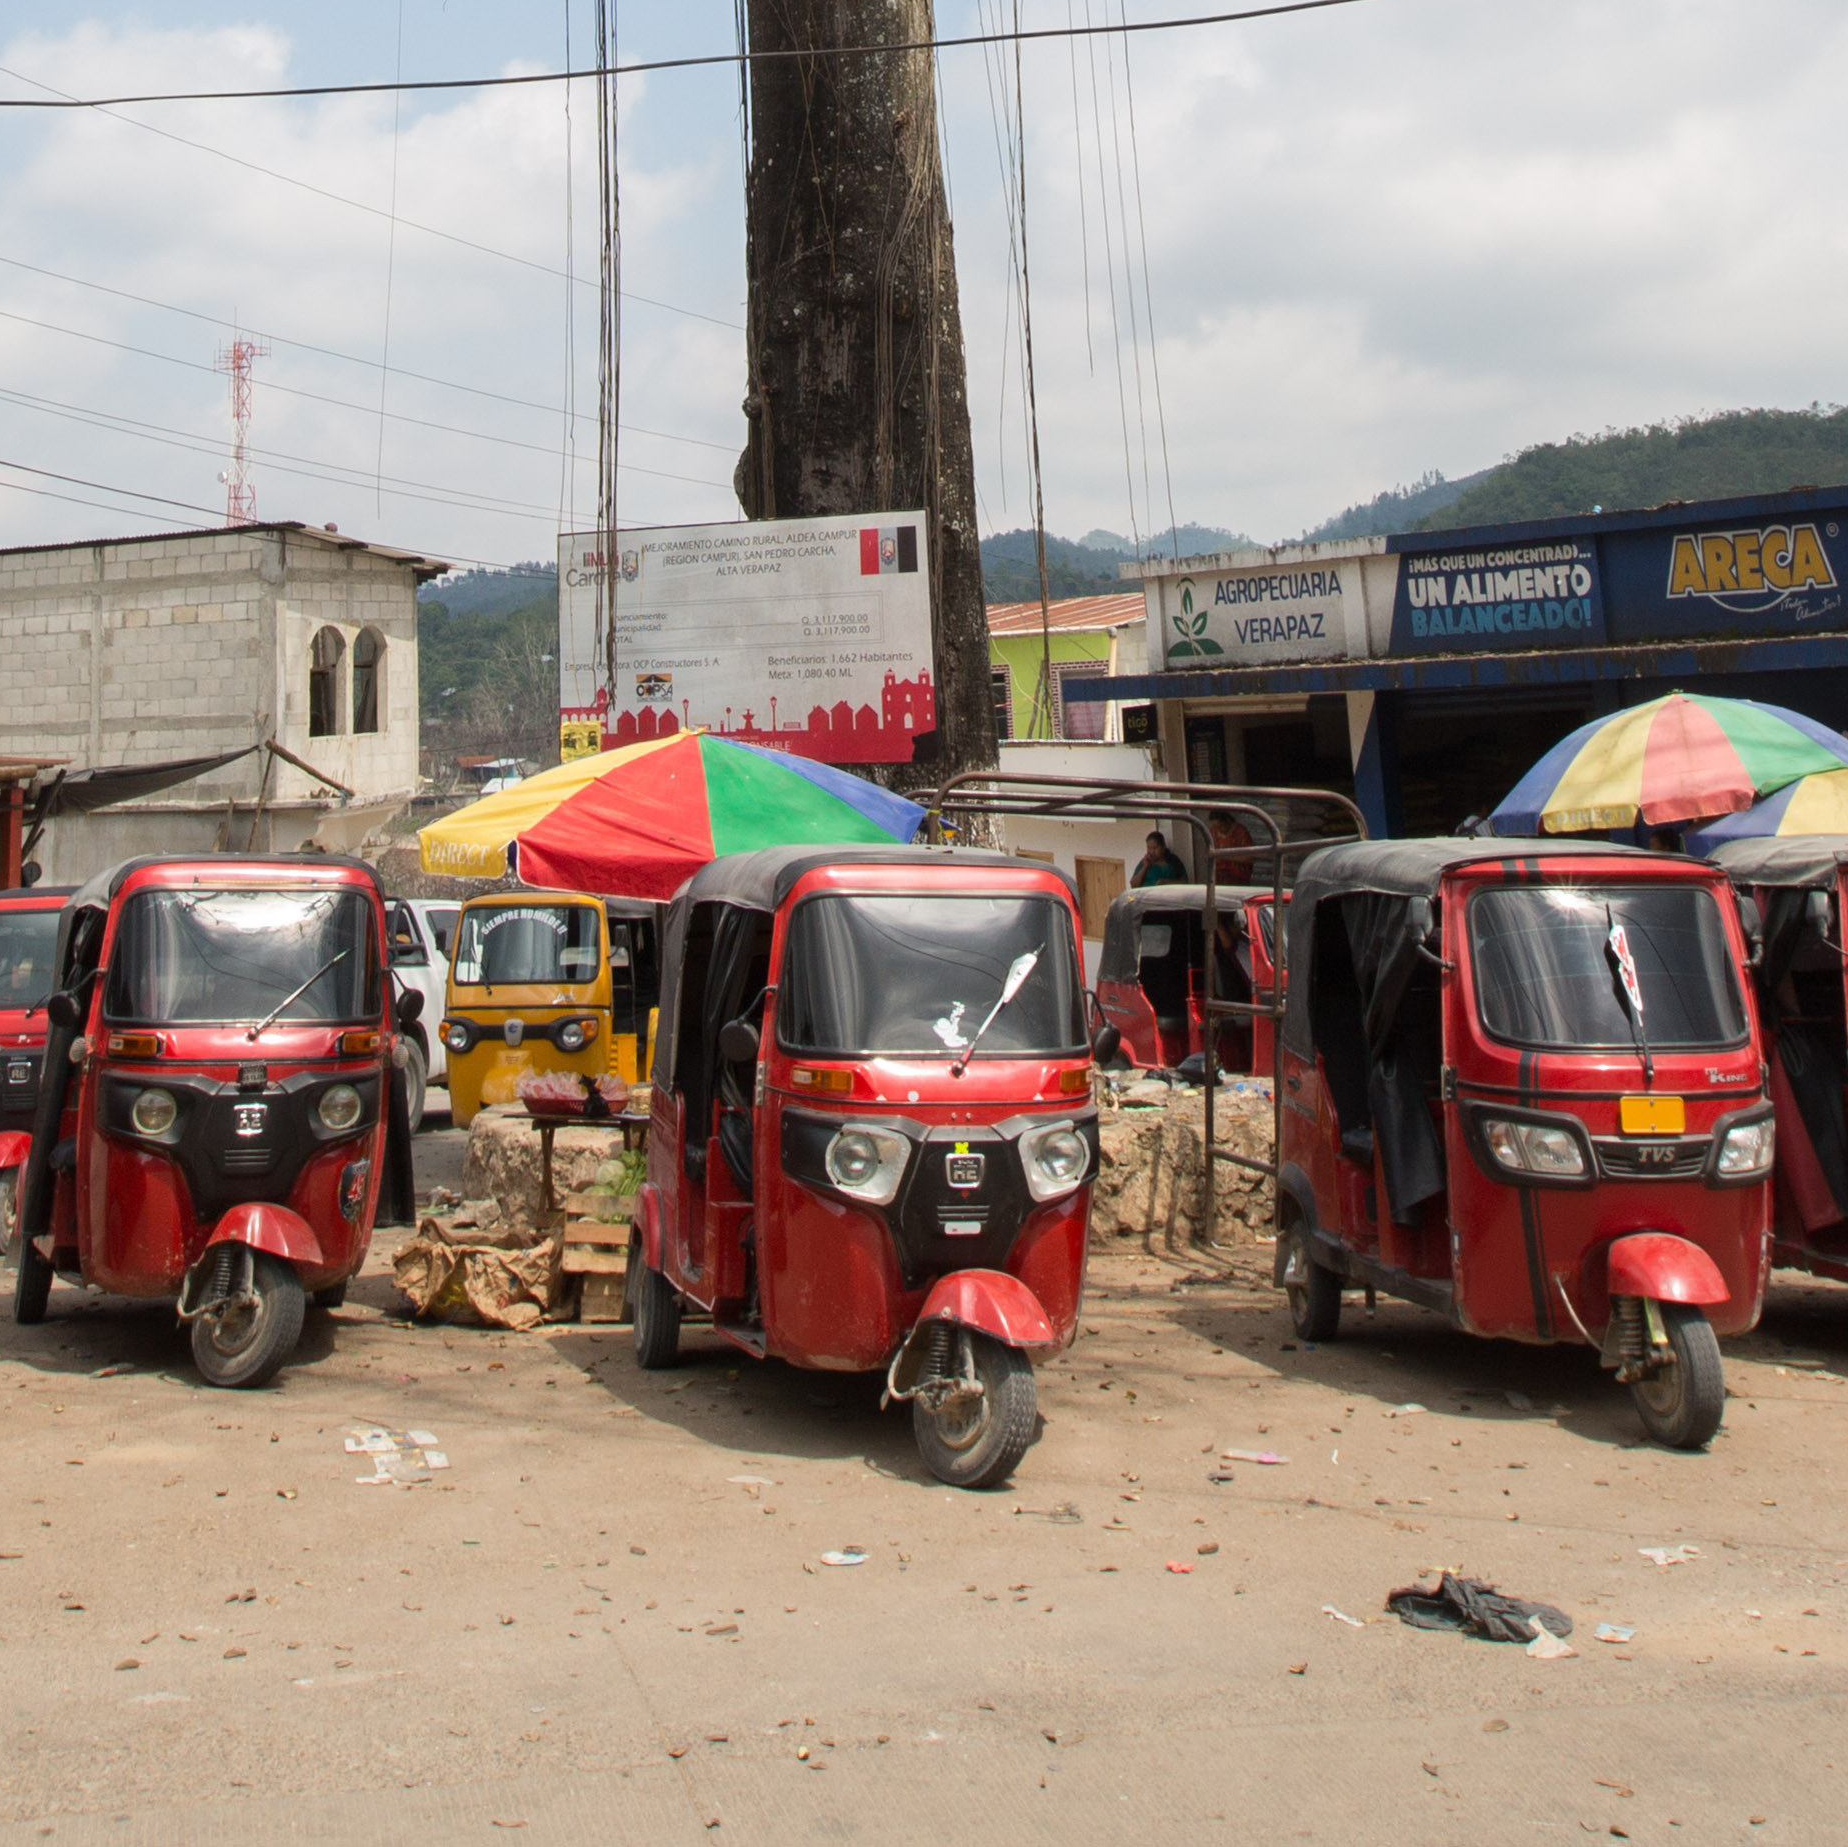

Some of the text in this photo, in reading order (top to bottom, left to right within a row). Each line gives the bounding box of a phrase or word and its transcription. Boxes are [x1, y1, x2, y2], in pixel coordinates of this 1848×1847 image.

[644, 538, 712, 552] MEJORAMIENTO
[714, 536, 750, 549] CAMINO
[786, 532, 816, 544] ALDEA
[818, 529, 857, 542] CAMPUR
[743, 549, 763, 561] SAN
[765, 547, 796, 560] PEDRO
[1408, 554, 1439, 574] ¡MÁS
[1439, 555, 1466, 572] QUE
[1466, 552, 1485, 569] UN
[1667, 523, 1838, 599] ARECA
[715, 562, 782, 576] ALTA VERAPAZ
[1214, 570, 1343, 605] AGROPECUARIA
[1407, 563, 1592, 608] UN ALIMENTO
[1411, 598, 1593, 638] BALANCEADO!
[615, 624, 663, 634] unicipalidad:
[1234, 612, 1326, 645] VERAPAZ
[615, 635, 634, 645] OTAL
[633, 659, 649, 670] OCP
[650, 657, 702, 670] Constructores
[768, 655, 828, 666] Beneficiarios:
[859, 652, 913, 663] Habitantes
[768, 669, 794, 680] Meta:
[839, 668, 853, 678] ML
[1556, 808, 1627, 827] DIRECT
[429, 840, 491, 867] DIRECT
[481, 909, 520, 936] SIEMPRE
[520, 908, 563, 930] HUMILDE
[1638, 1146, 1676, 1163] TVS
